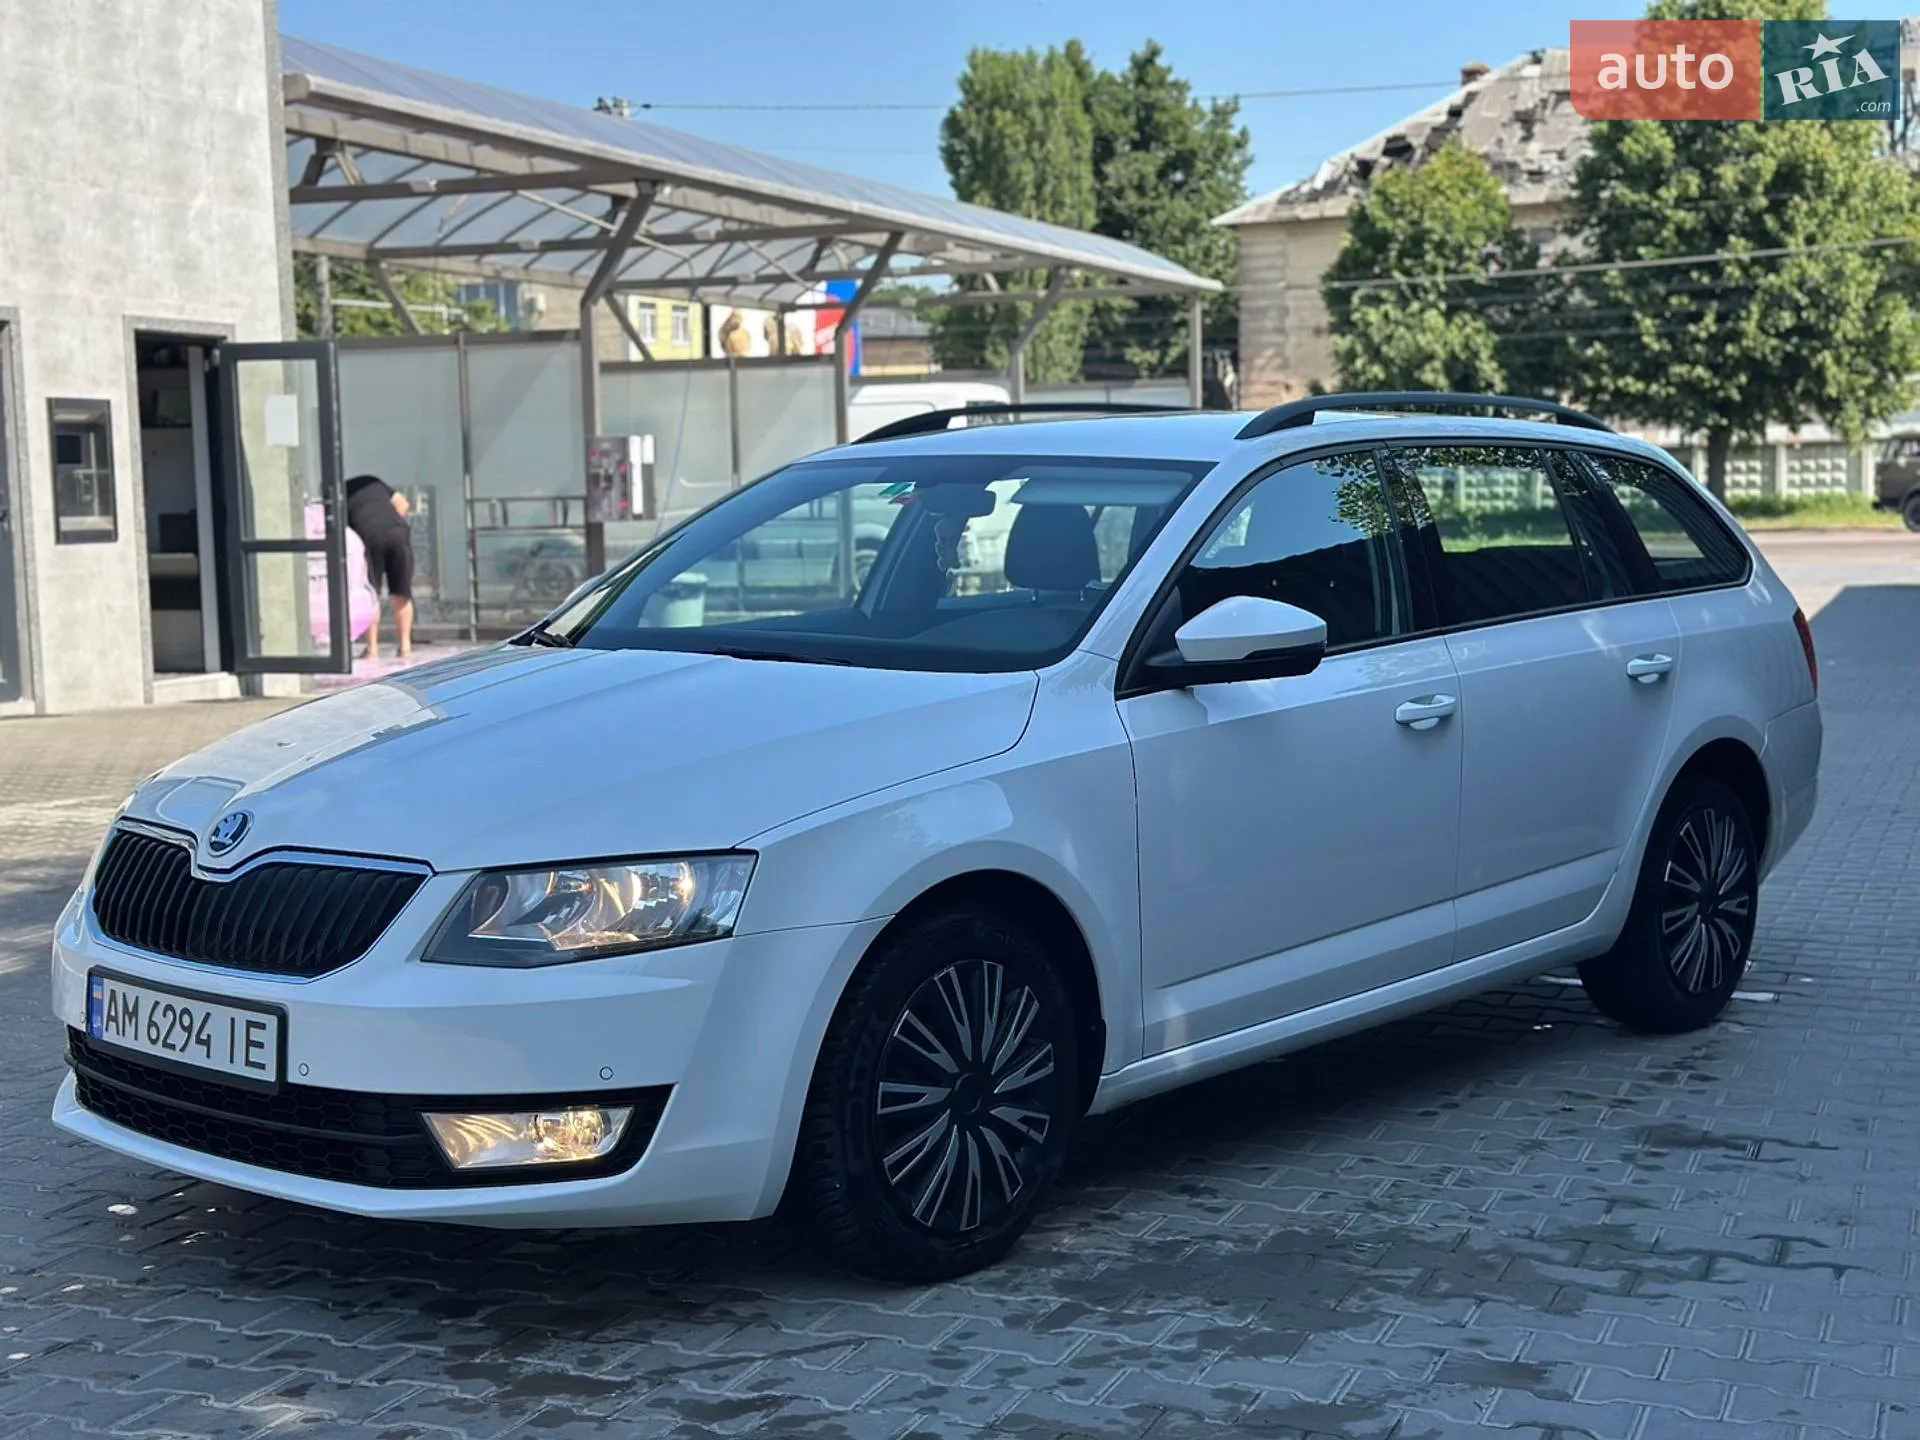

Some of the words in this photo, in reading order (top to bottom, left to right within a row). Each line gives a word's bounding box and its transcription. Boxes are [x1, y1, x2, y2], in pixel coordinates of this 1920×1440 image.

[104, 988, 139, 1041] AM
[146, 1000, 212, 1059] 6294
[229, 1016, 267, 1071] IE
